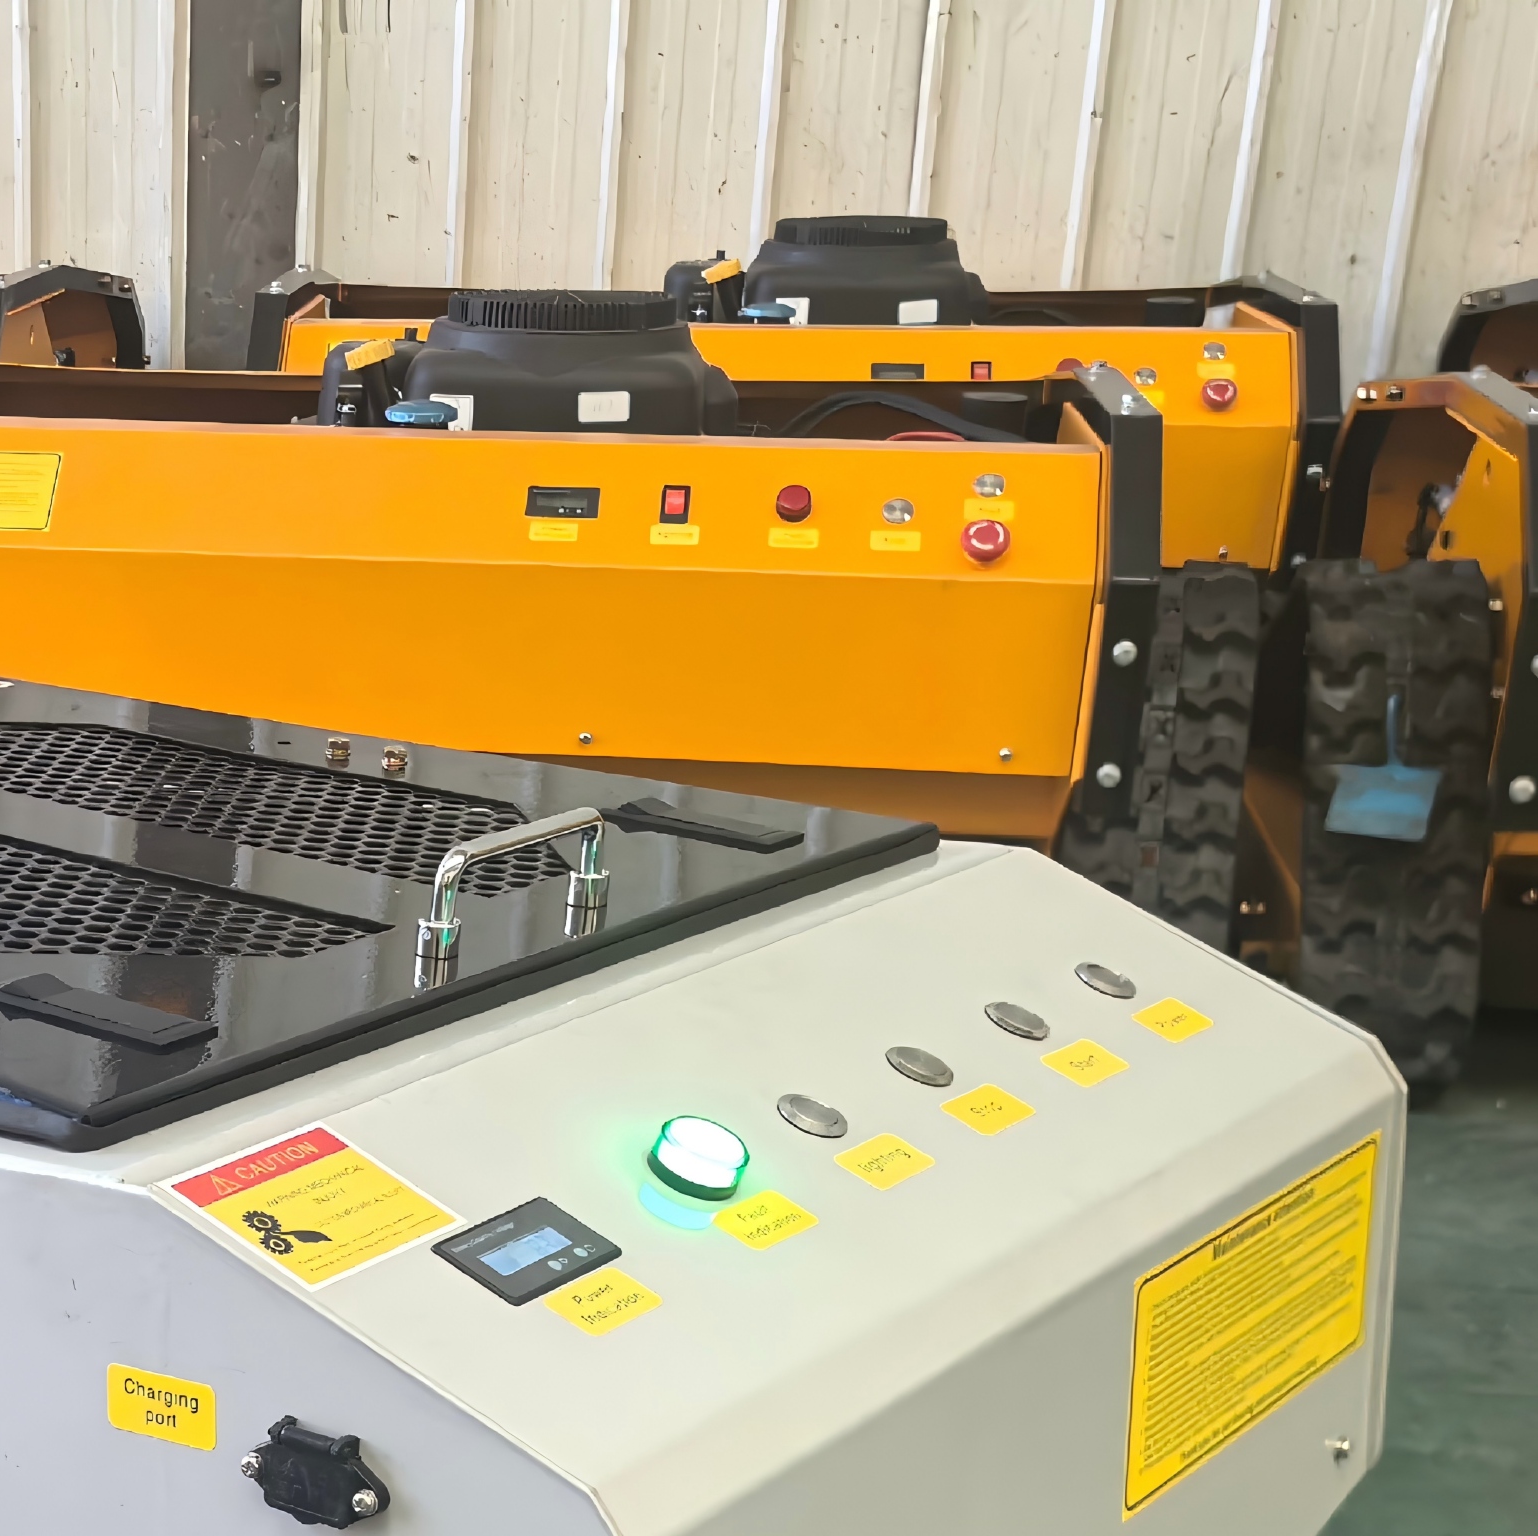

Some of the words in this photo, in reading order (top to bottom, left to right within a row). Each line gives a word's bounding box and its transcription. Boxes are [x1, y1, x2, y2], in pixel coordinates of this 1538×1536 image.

[234, 1140, 320, 1181] CAUTION
[123, 1377, 199, 1414] Charging
[145, 1410, 177, 1428] port
